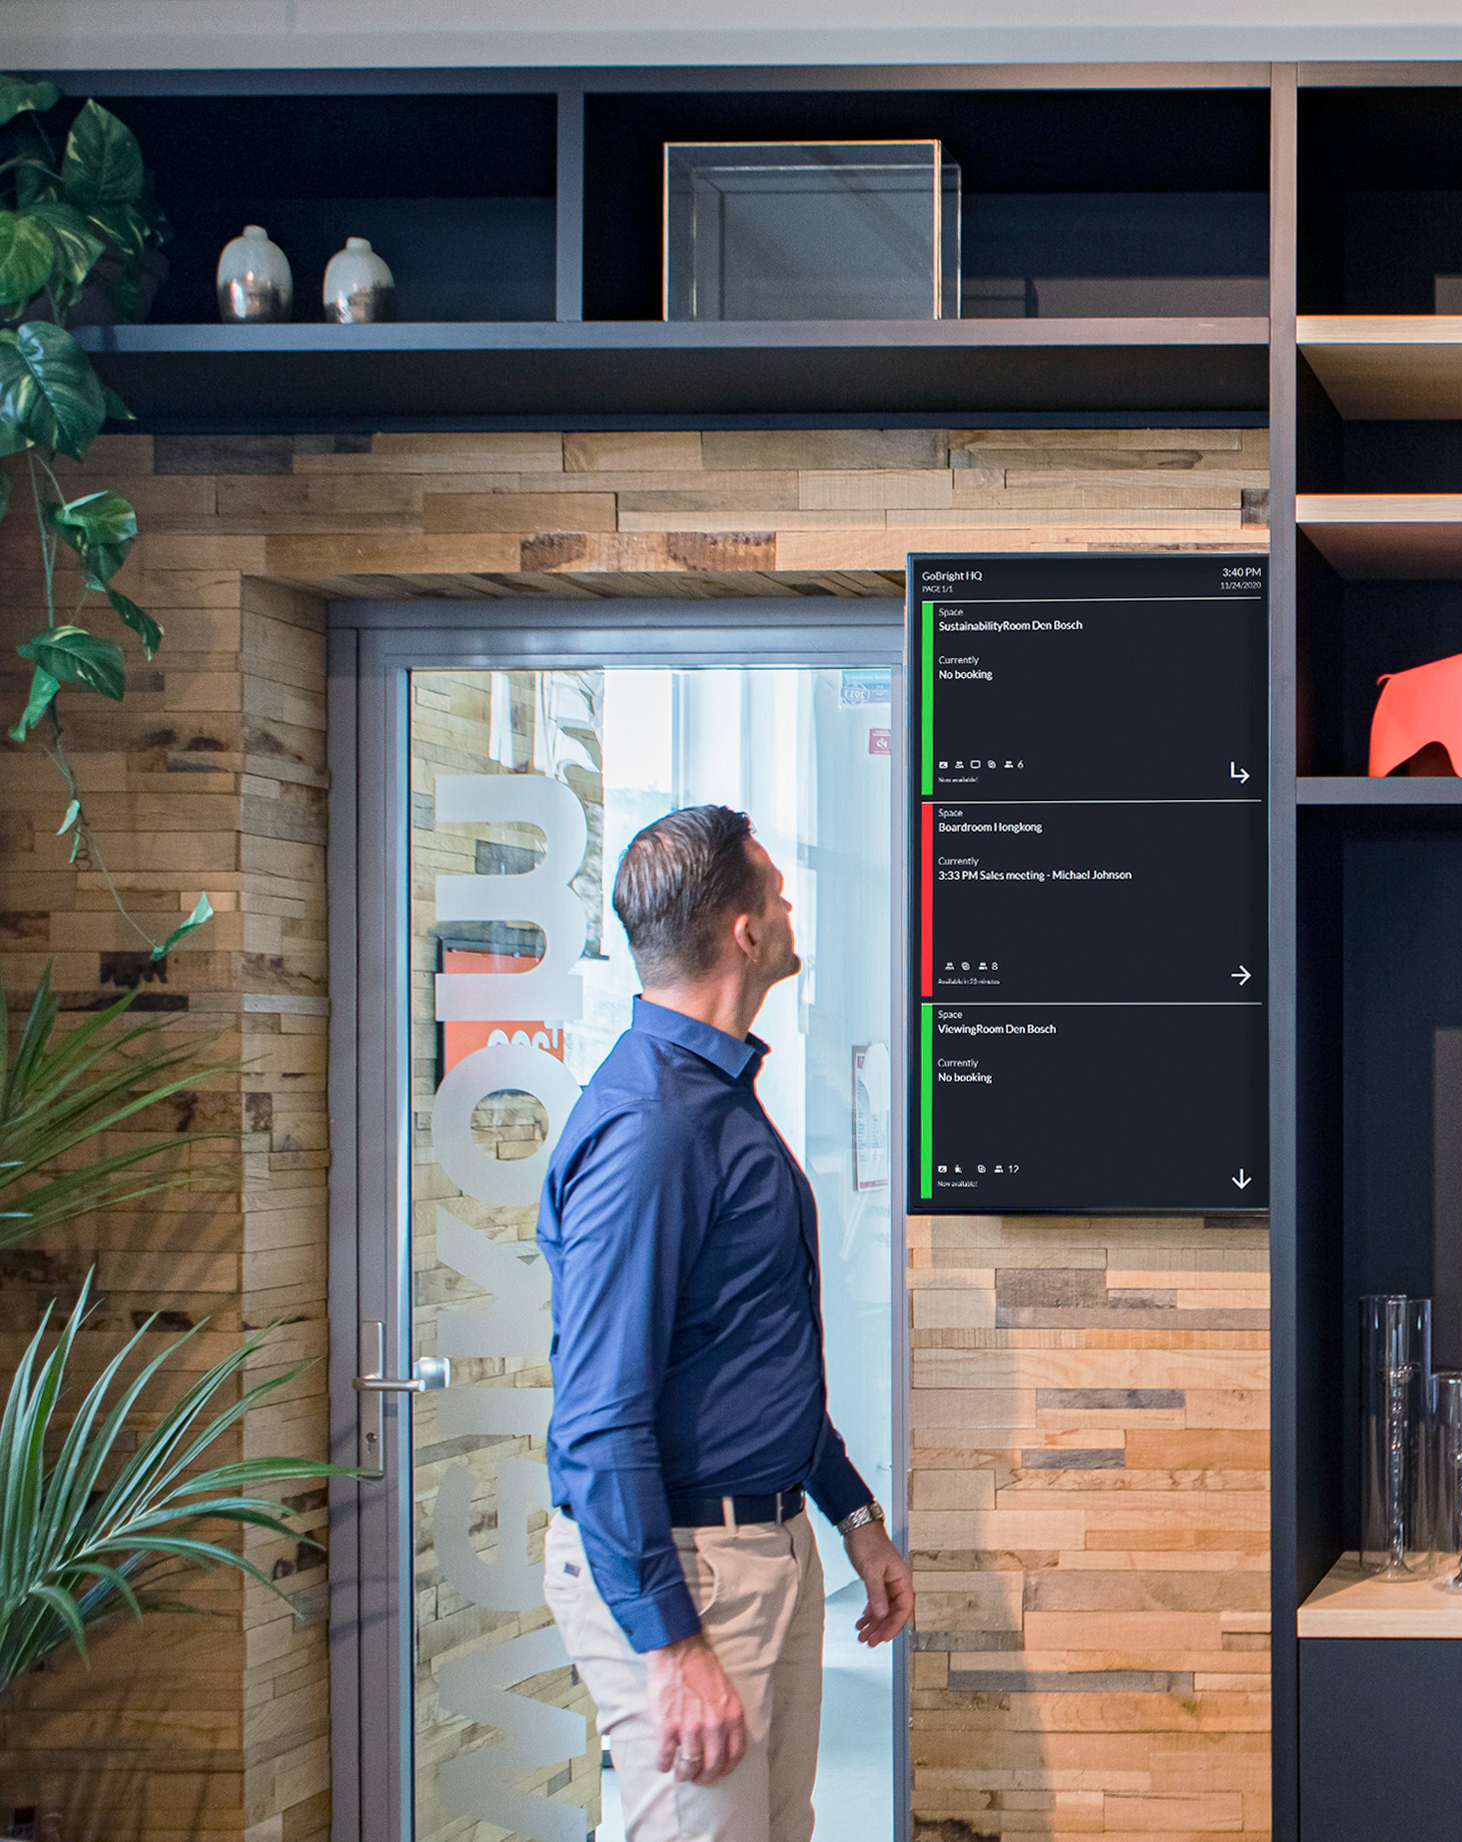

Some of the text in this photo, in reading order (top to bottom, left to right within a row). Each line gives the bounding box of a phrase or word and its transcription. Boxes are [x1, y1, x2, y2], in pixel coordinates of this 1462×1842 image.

[922, 571, 982, 581] GoBright HQ
[1223, 567, 1261, 577] 3:40 PM
[939, 608, 963, 617] Space
[939, 620, 1082, 632] SustainabilityRoom Den Bosch
[939, 656, 979, 665] Currently
[939, 670, 993, 681] No booking
[1017, 760, 1023, 768] 6
[938, 808, 963, 818] Space
[939, 823, 1042, 834] Boardroom Hongkong
[938, 857, 979, 866] Currently
[939, 870, 1132, 882] 3:33 PM Sales meeting Michael Johnson
[992, 962, 998, 970] 8
[938, 1010, 962, 1020] Space
[938, 1024, 1056, 1035] ViewingRoom Den Bosch
[938, 1058, 979, 1068] Currently
[939, 1073, 992, 1083] No booking
